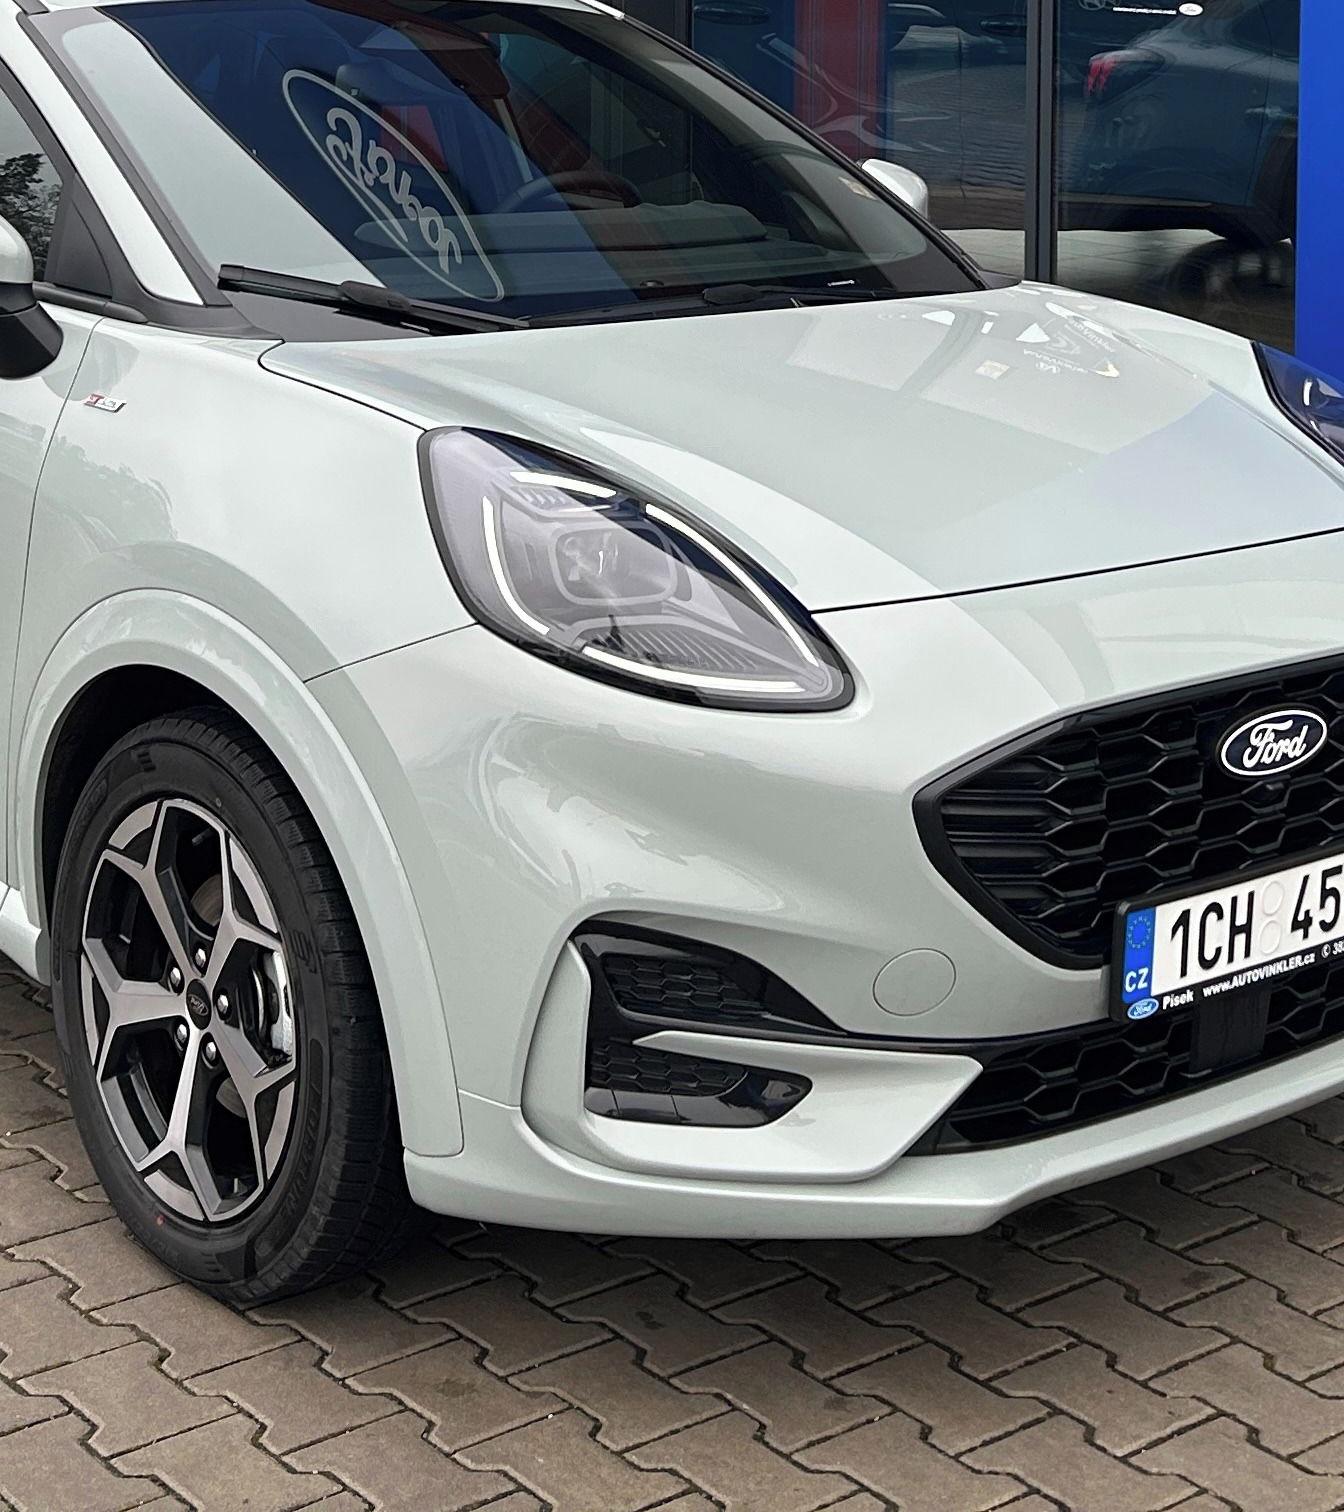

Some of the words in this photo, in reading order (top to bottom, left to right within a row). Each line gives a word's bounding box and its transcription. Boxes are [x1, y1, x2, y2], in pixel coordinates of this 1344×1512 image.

[1242, 719, 1308, 769] Ford
[1169, 890, 1255, 979] 1CH
[1124, 966, 1149, 993] CZ
[1202, 952, 1316, 998] www.AUTOVINKLER.cz
